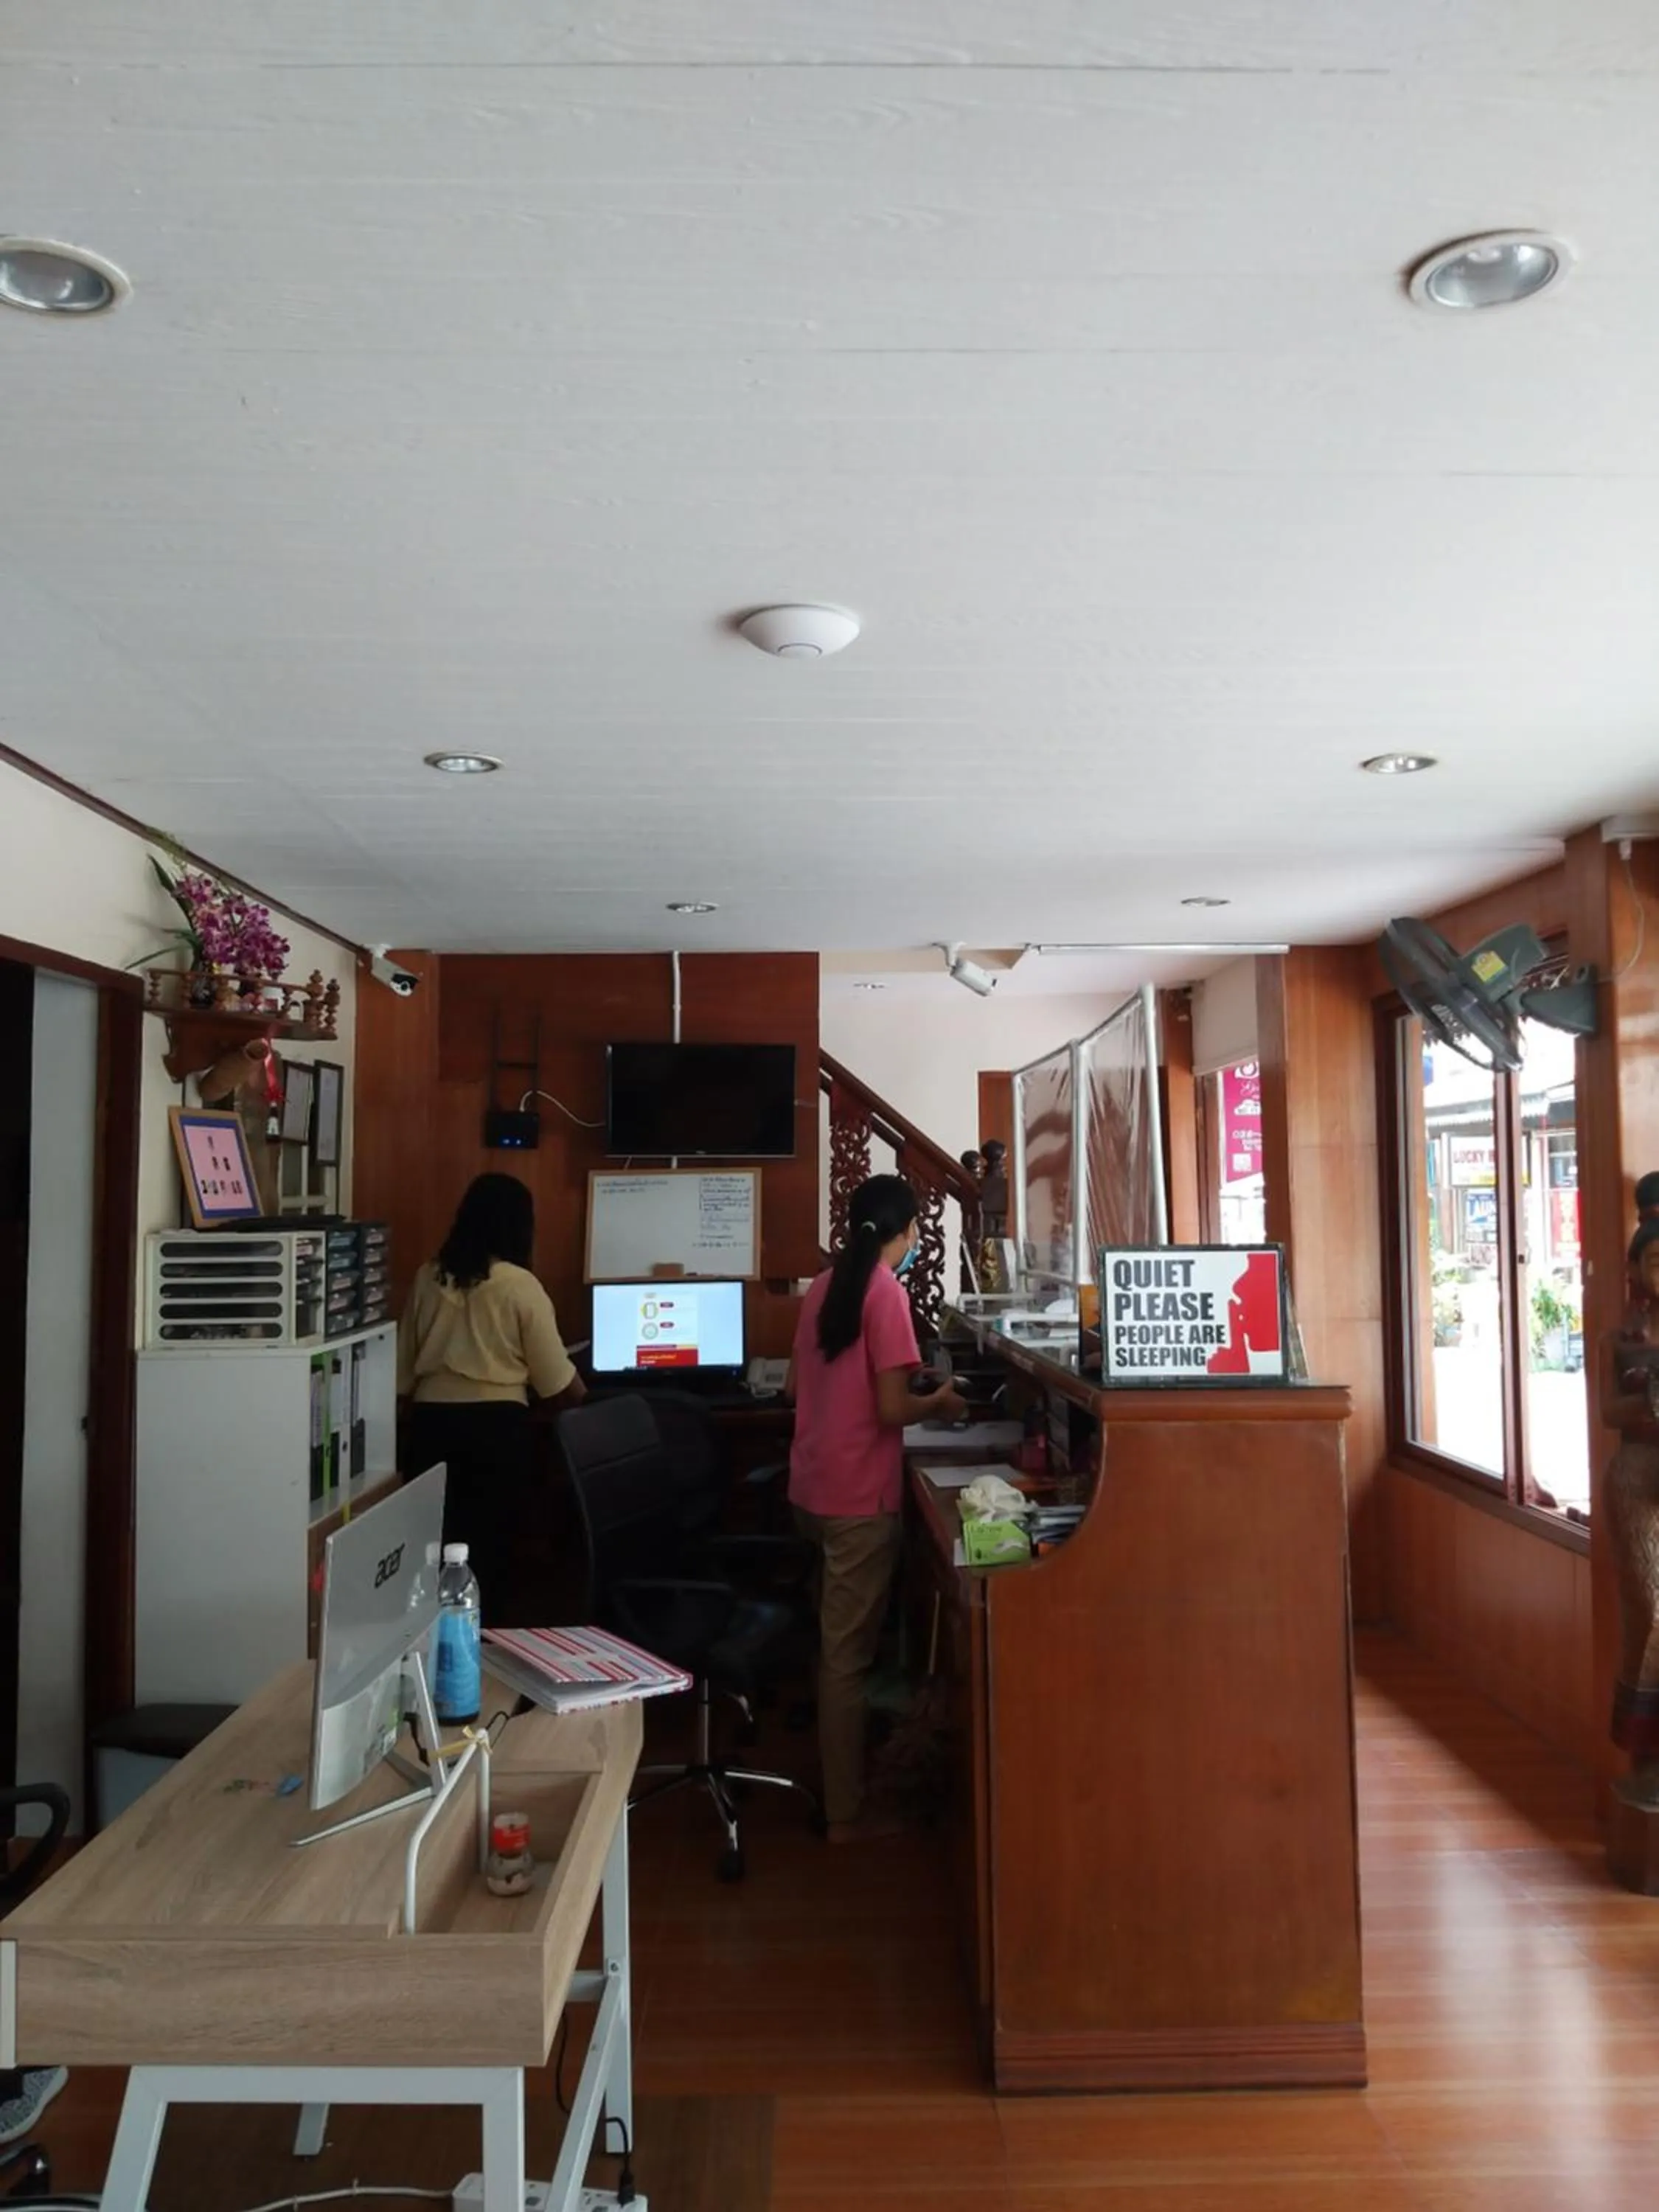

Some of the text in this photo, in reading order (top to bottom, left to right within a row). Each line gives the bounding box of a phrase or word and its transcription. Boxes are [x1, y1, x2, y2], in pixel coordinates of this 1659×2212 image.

[1453, 1150, 1484, 1164] LUCKY
[1113, 1259, 1195, 1291] QUIET
[1114, 1293, 1214, 1321] PLEASE
[1115, 1324, 1225, 1345] PEOPLE ARE
[1116, 1346, 1206, 1367] SLEEPING
[374, 1542, 405, 1589] acer
